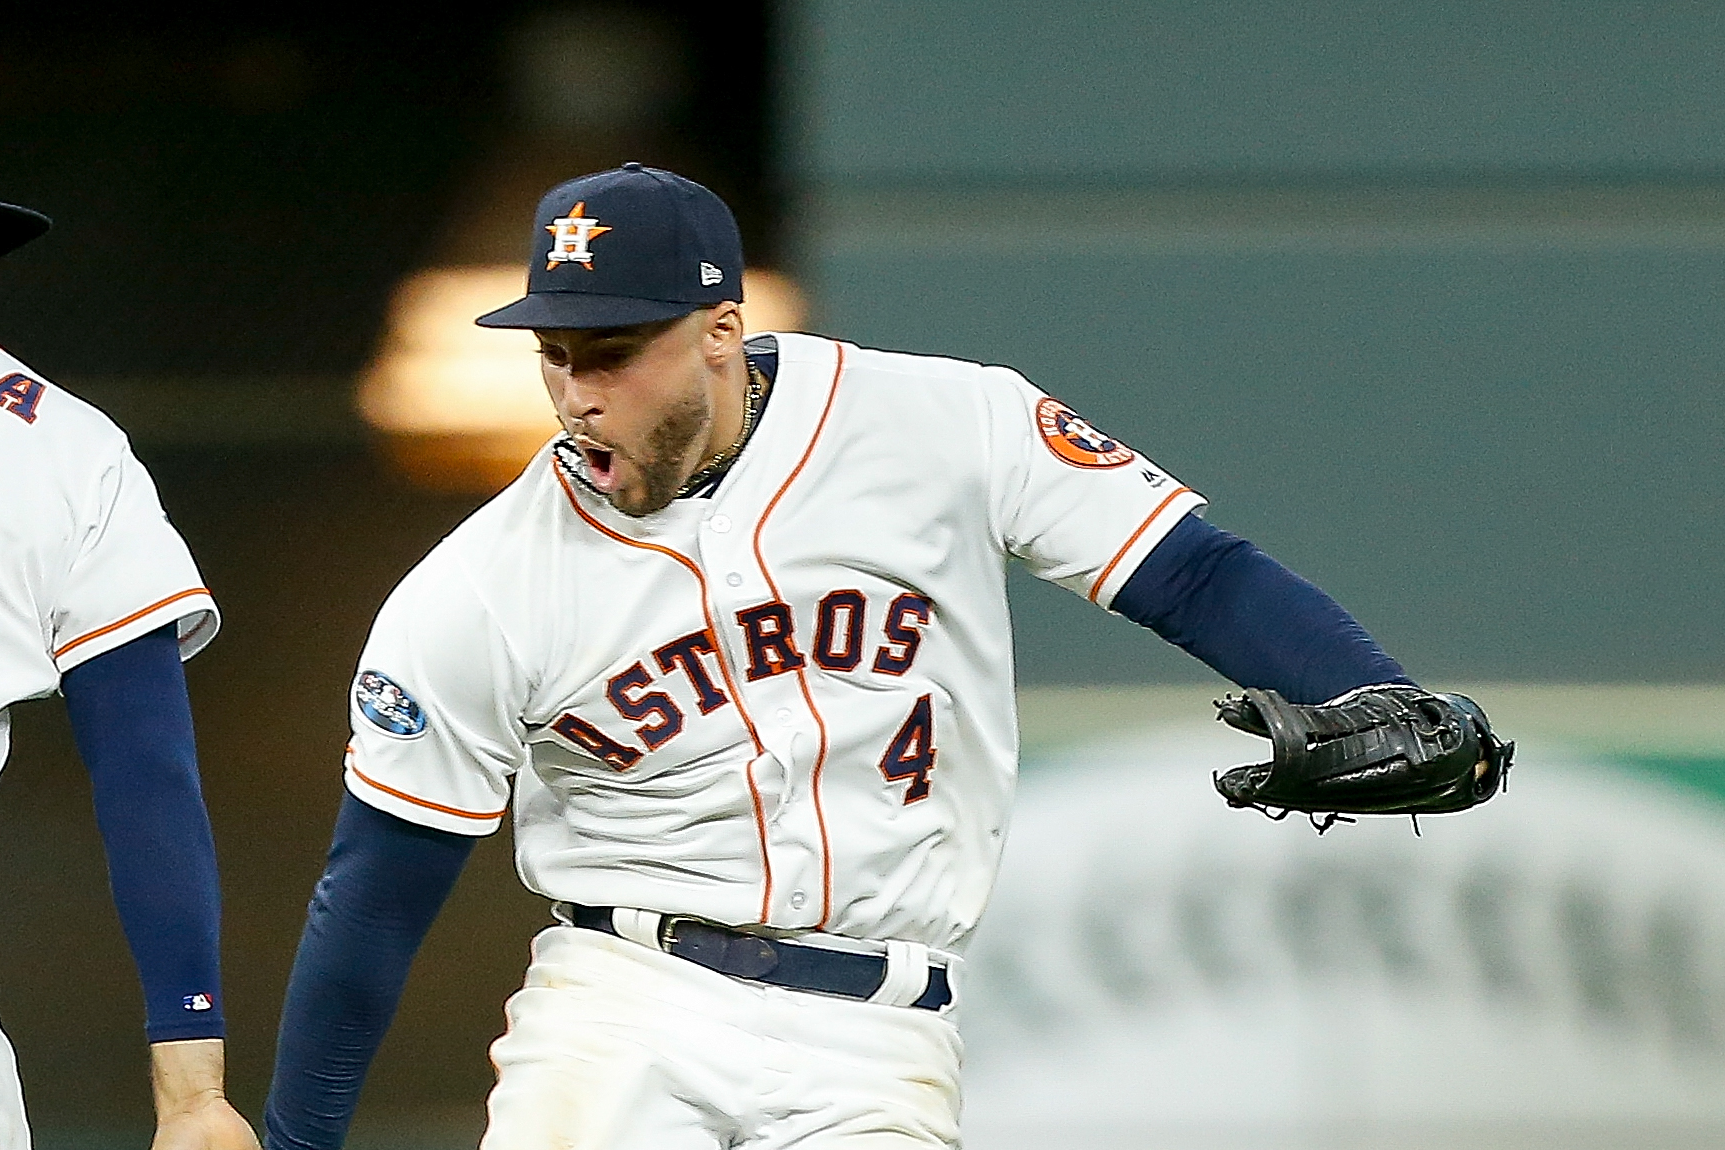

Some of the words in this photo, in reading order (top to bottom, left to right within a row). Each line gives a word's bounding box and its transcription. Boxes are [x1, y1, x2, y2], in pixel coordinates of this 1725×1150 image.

[547, 217, 600, 262] H
[550, 588, 932, 772] ASTROS
[878, 692, 938, 806] 4
